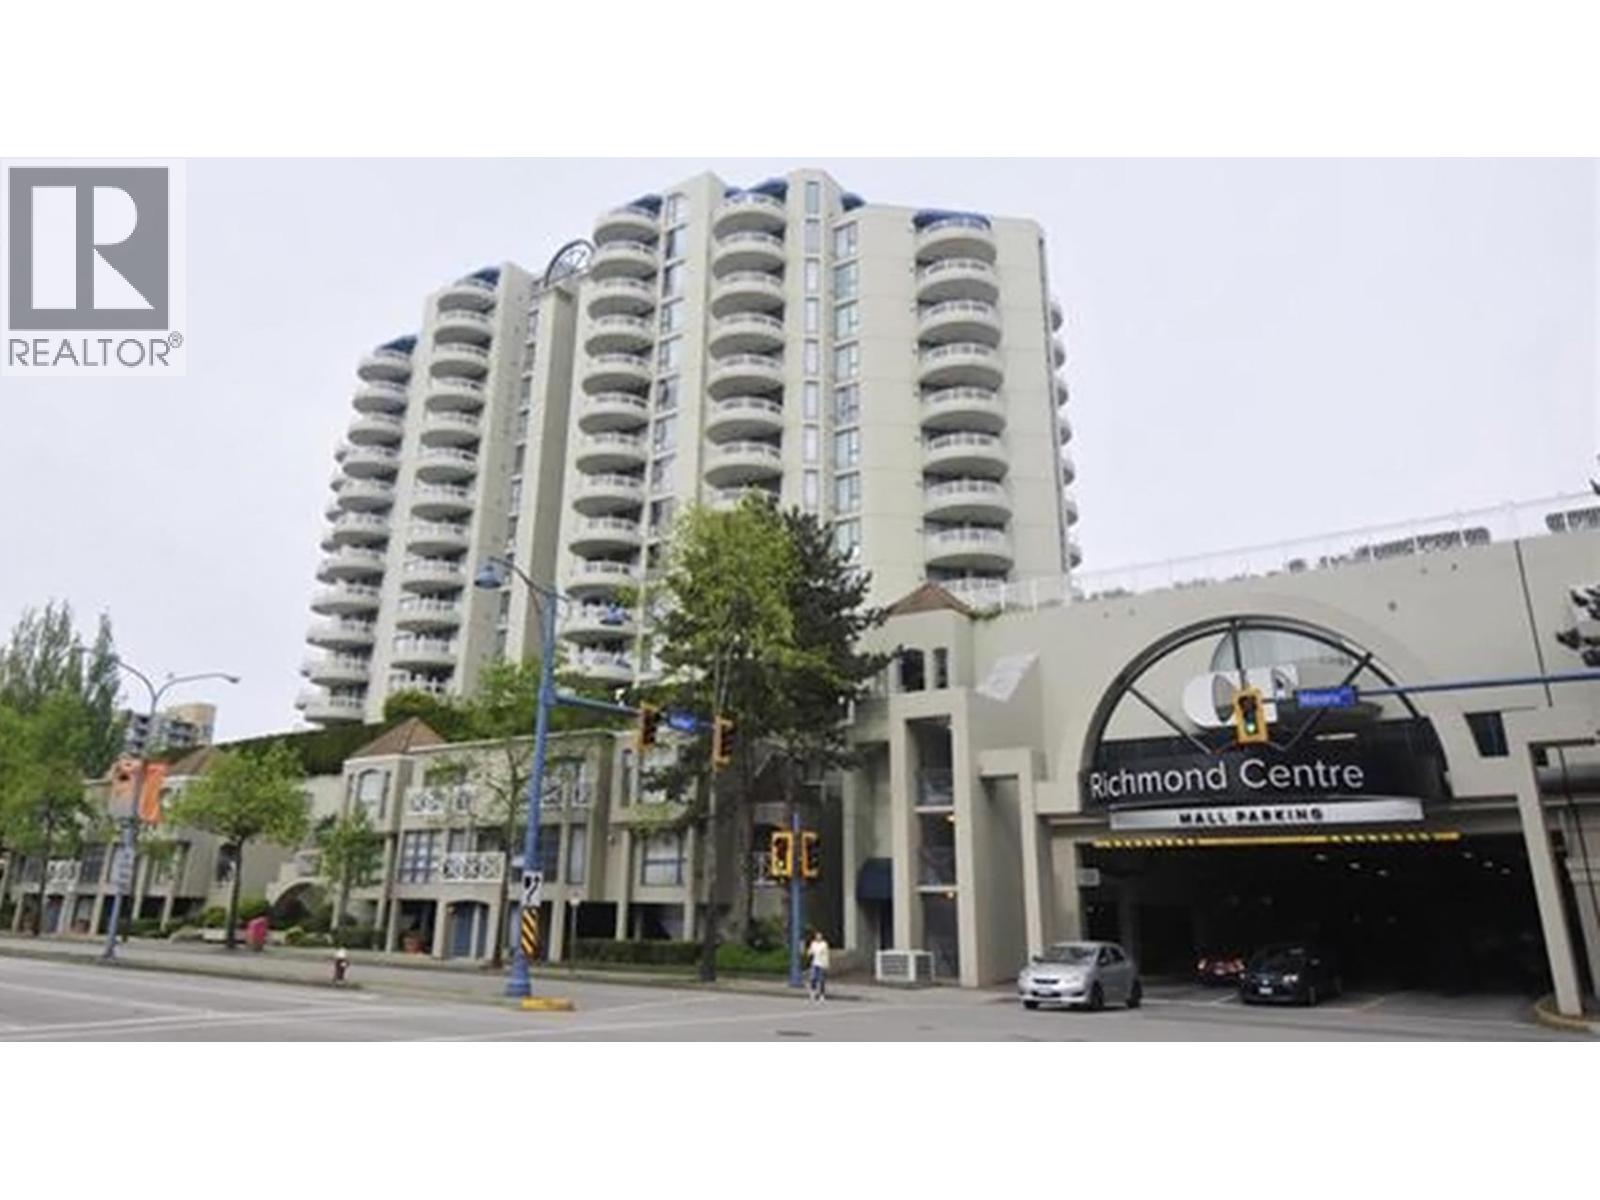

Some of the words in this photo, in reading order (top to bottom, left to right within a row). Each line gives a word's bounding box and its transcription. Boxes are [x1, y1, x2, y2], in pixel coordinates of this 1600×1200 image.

[1091, 760, 1227, 800] Richmond
[1239, 759, 1364, 789] Centre
[1180, 812, 1228, 825] MALL
[1238, 809, 1323, 823] PARKING
